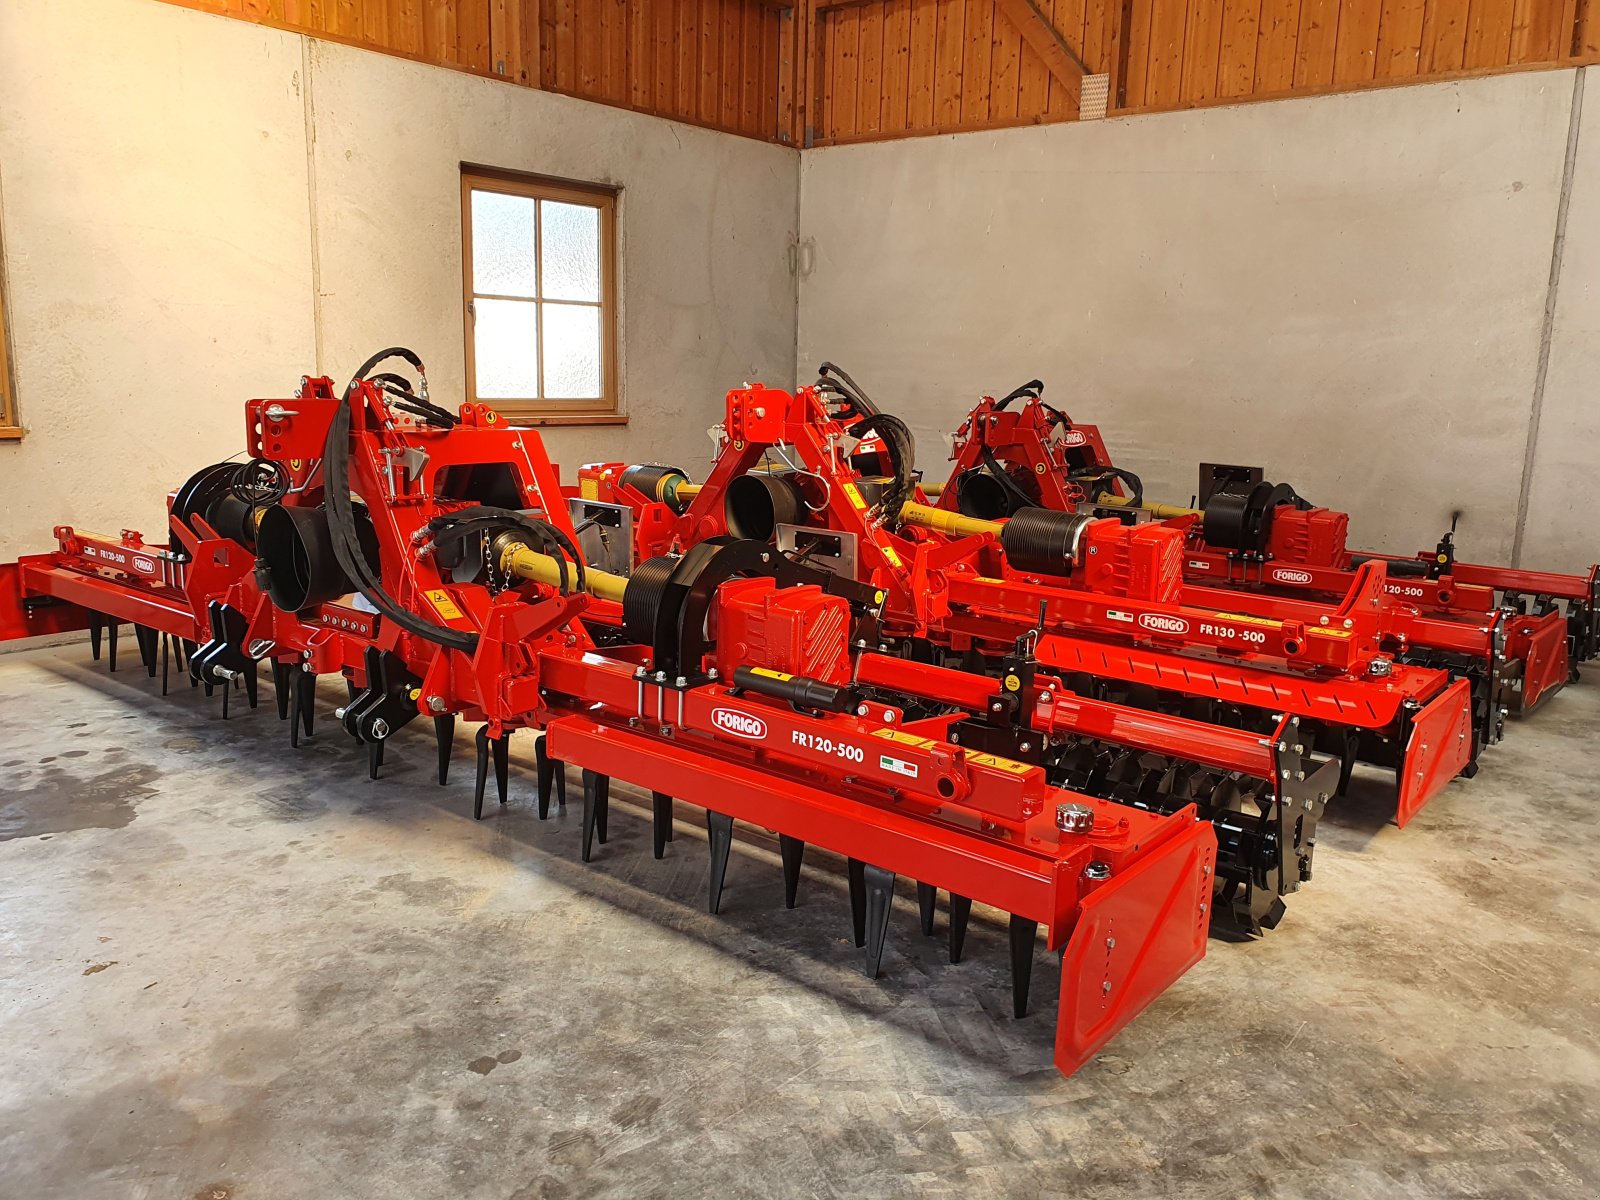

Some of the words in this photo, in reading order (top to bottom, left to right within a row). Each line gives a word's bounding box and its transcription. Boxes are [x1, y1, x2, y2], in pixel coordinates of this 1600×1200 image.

[135, 558, 153, 571] FORIGO
[1276, 570, 1309, 582] FORIGO
[1383, 585, 1423, 597] 120-500
[1144, 615, 1184, 632] FORIGO
[1200, 624, 1236, 638] FR130
[1238, 630, 1266, 643] -500
[717, 710, 762, 736] FORIGO
[792, 730, 864, 763] FR120-500
